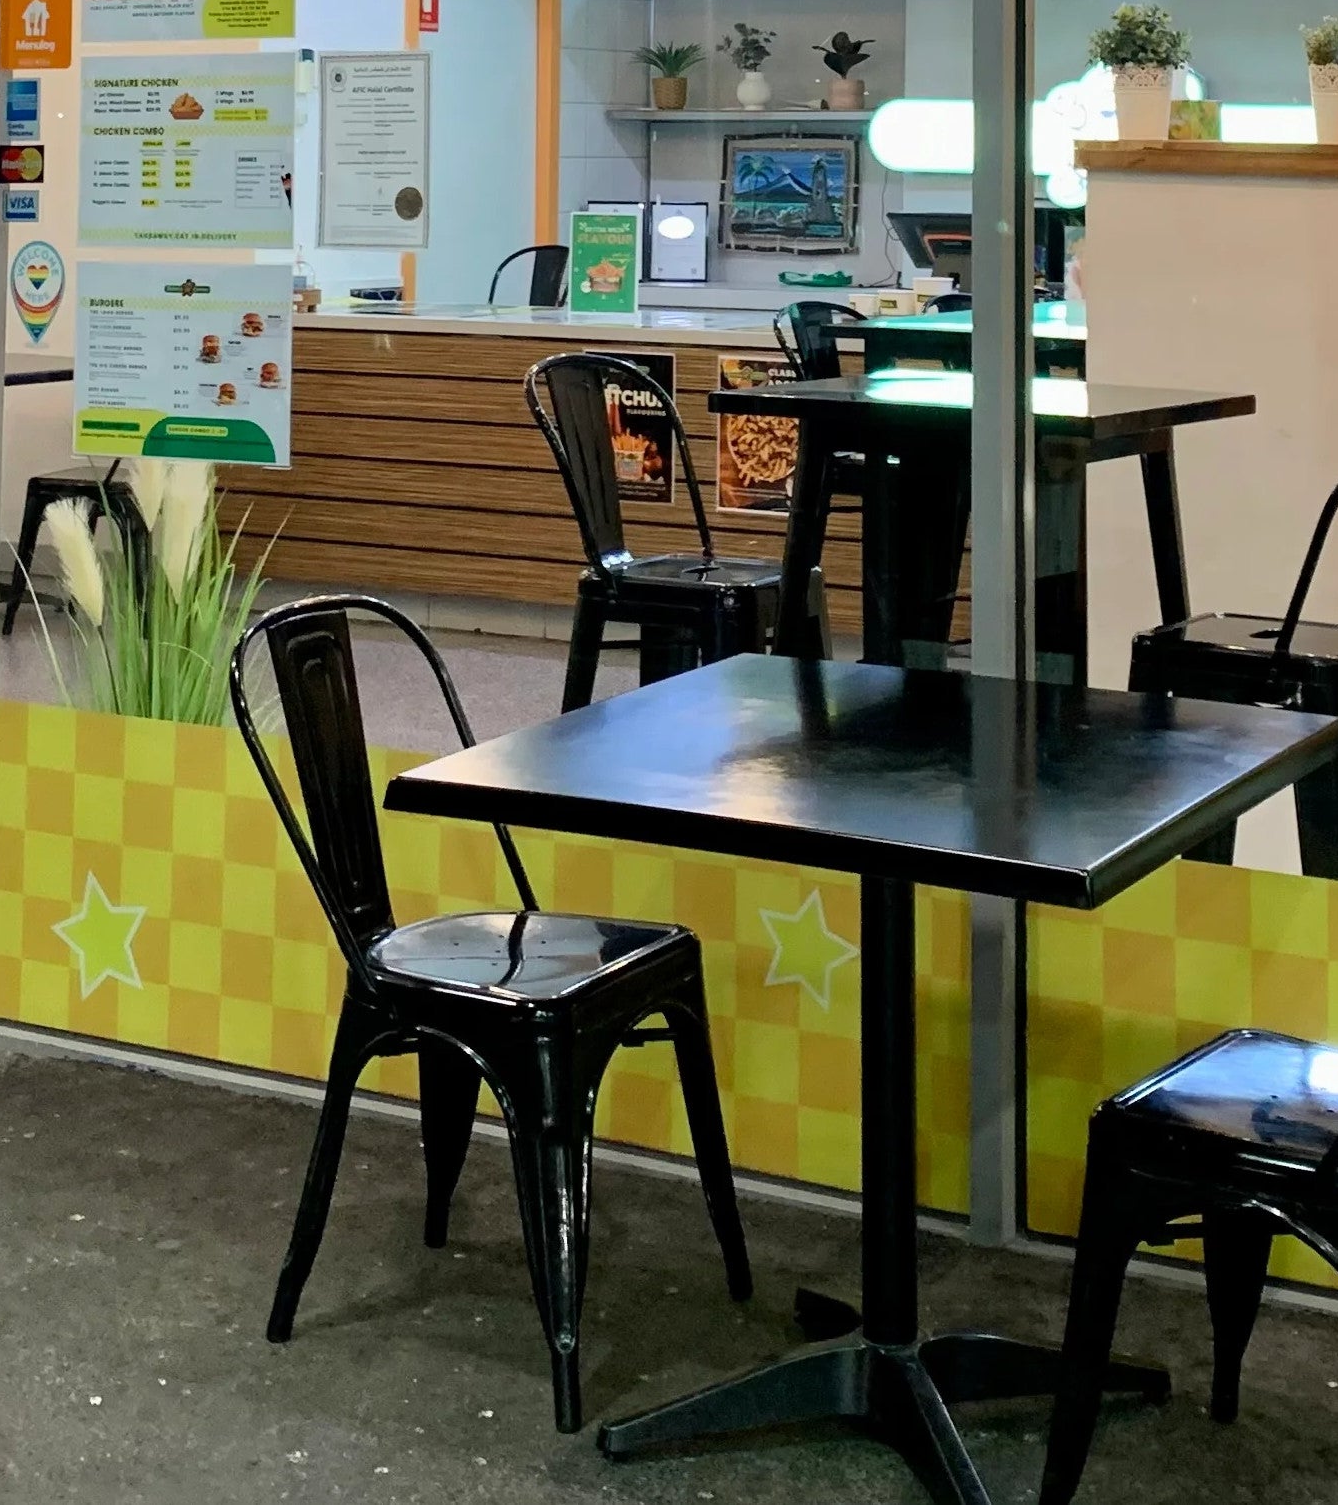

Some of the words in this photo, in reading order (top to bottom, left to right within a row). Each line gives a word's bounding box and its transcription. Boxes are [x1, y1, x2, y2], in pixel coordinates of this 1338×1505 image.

[16, 40, 55, 52] Menulog
[94, 79, 138, 87] SIGNATURE
[141, 78, 179, 87] CHICKEN
[94, 127, 130, 135] CHICKEN
[133, 127, 165, 135] COMBO
[11, 196, 35, 209] VISA
[17, 248, 60, 276] WELCOME
